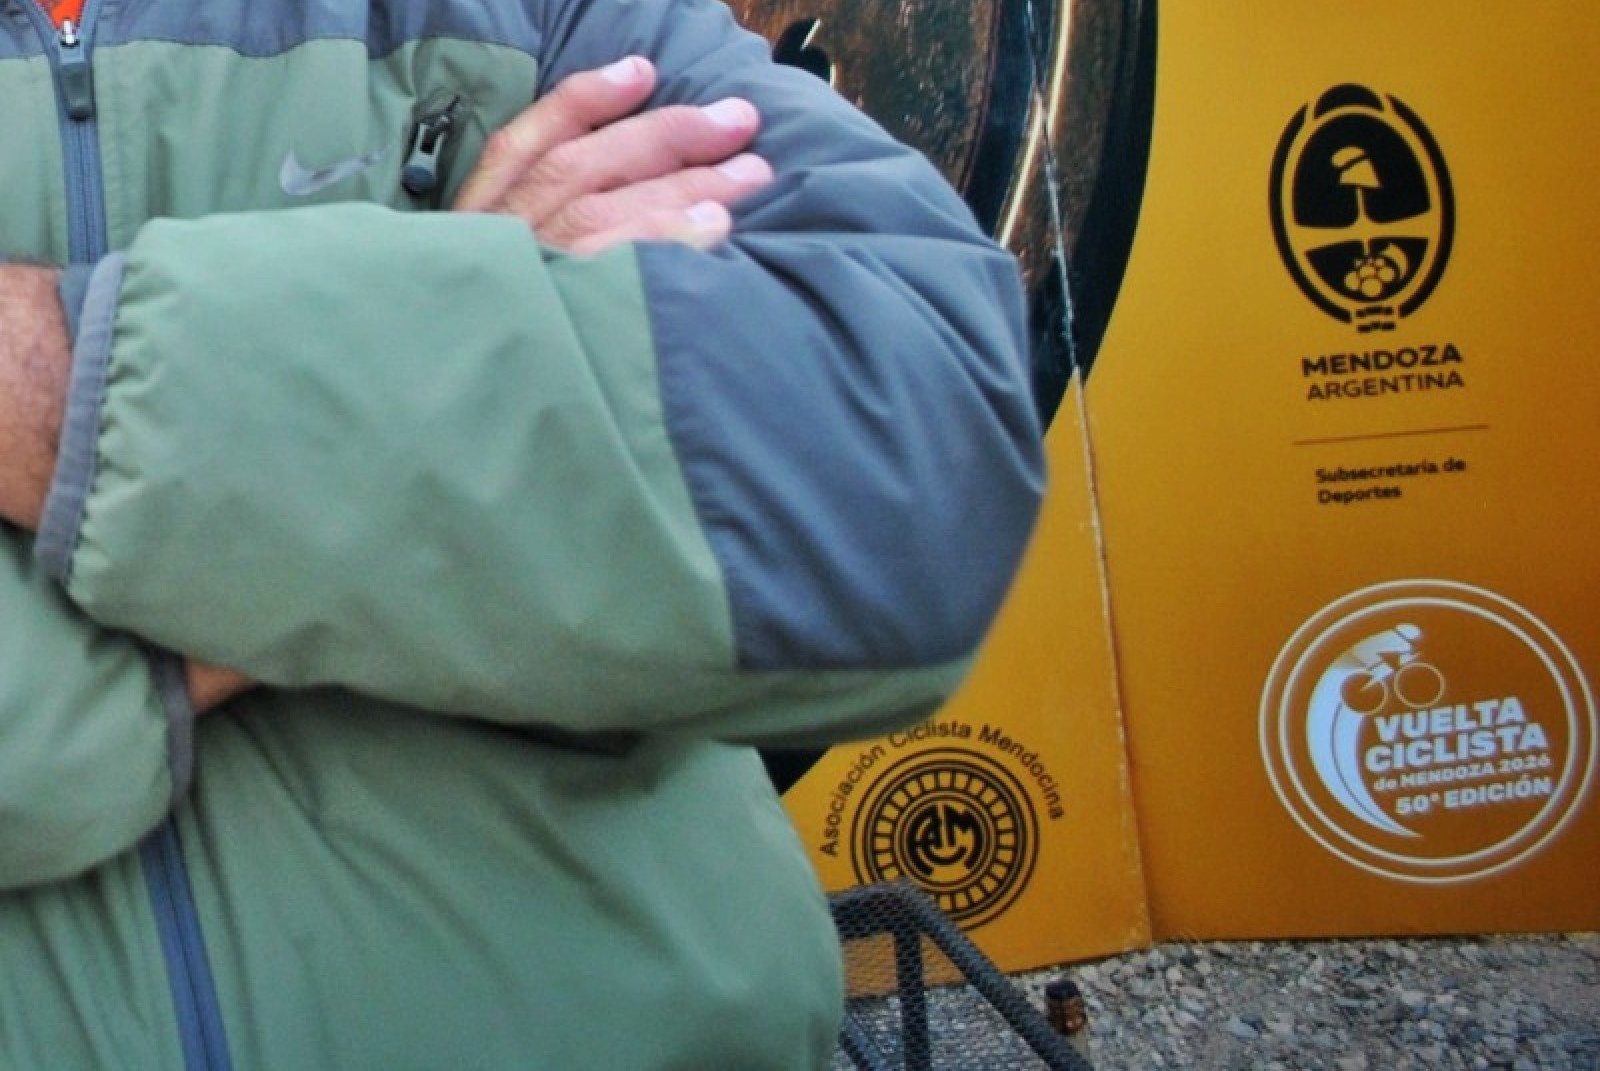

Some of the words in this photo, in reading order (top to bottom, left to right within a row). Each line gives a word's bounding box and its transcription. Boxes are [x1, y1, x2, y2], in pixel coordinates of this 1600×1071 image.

[1302, 342, 1463, 378] MENDOZA
[1307, 370, 1465, 402] ARGENTINA
[1442, 457, 1466, 473] de
[1318, 485, 1402, 505] Deportes
[1374, 696, 1526, 742] VUELTA
[1365, 723, 1548, 773] CICLISTA
[819, 744, 886, 857] Asociación
[888, 720, 971, 749] Ciclista
[978, 724, 1064, 820] Mendocina
[1401, 761, 1495, 788] MENDOZA
[1443, 775, 1551, 809] EDICIÓN
